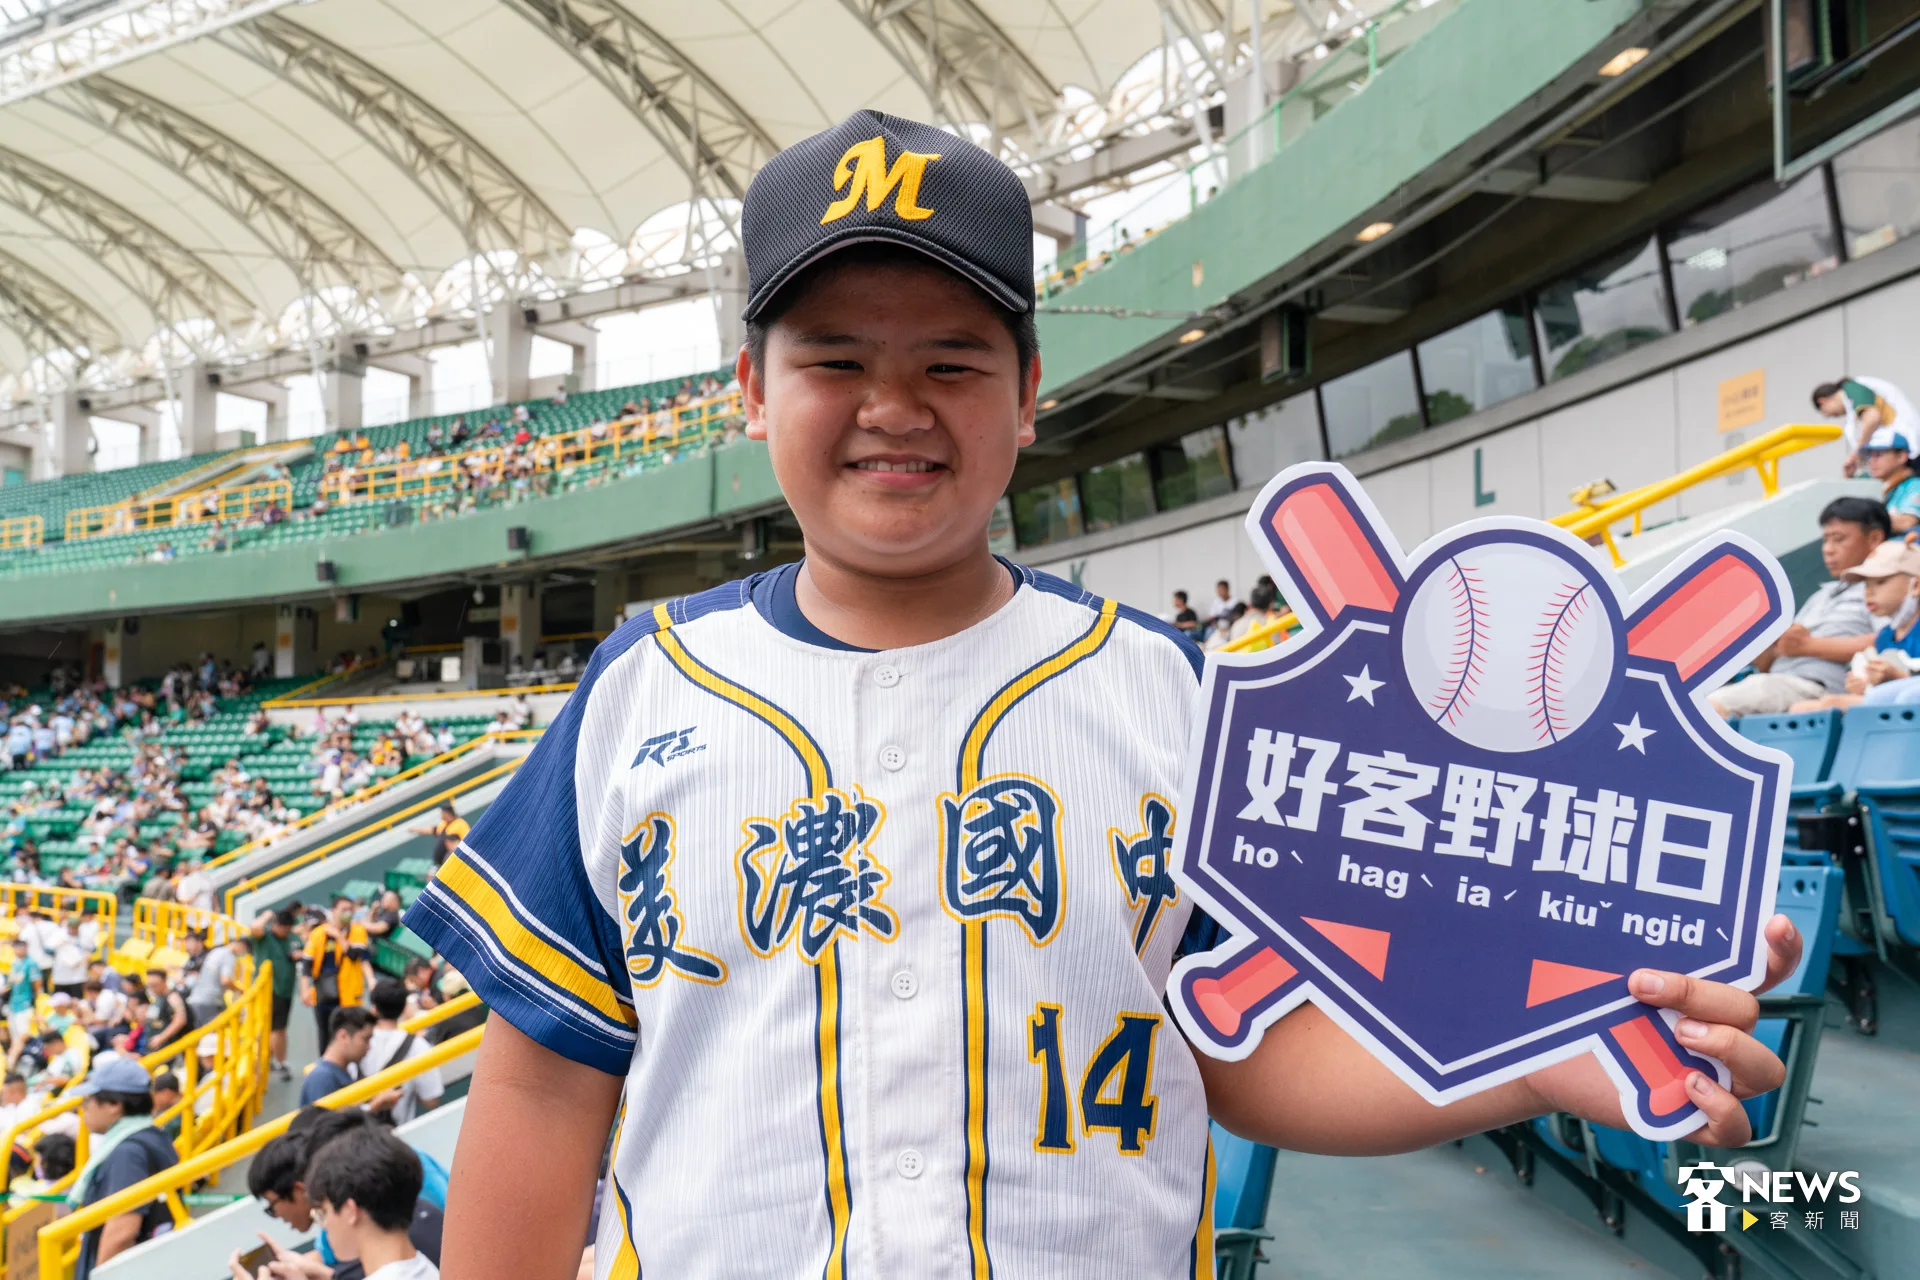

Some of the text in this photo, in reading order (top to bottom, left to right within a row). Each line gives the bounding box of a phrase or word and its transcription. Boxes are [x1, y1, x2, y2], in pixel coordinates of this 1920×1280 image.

[820, 135, 942, 226] M
[1474, 447, 1496, 508] L
[666, 743, 708, 762] SPORTS
[1236, 727, 1733, 905] 好客野球日
[1027, 1003, 1163, 1155] 14
